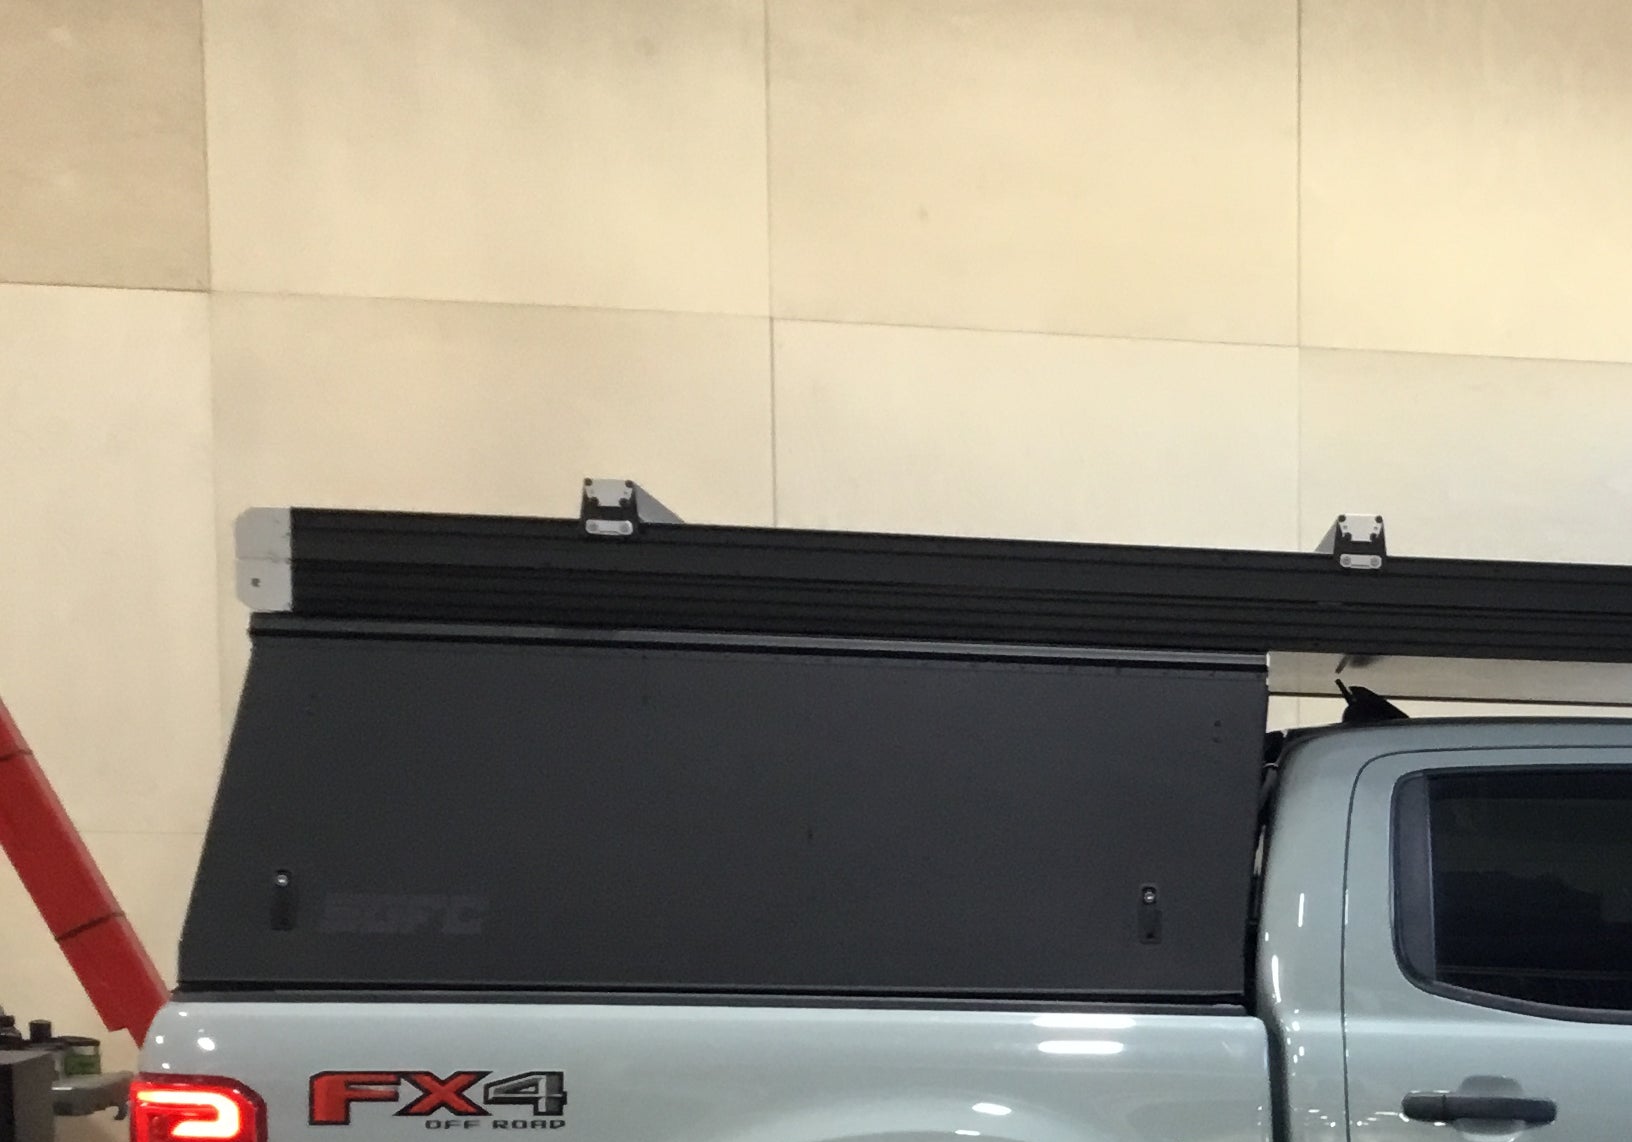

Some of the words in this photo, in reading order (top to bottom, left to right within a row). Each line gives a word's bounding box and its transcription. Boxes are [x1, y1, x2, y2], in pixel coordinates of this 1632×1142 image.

[308, 1071, 568, 1125] FX4
[424, 1119, 481, 1129] OFF
[492, 1119, 566, 1130] ROAD
